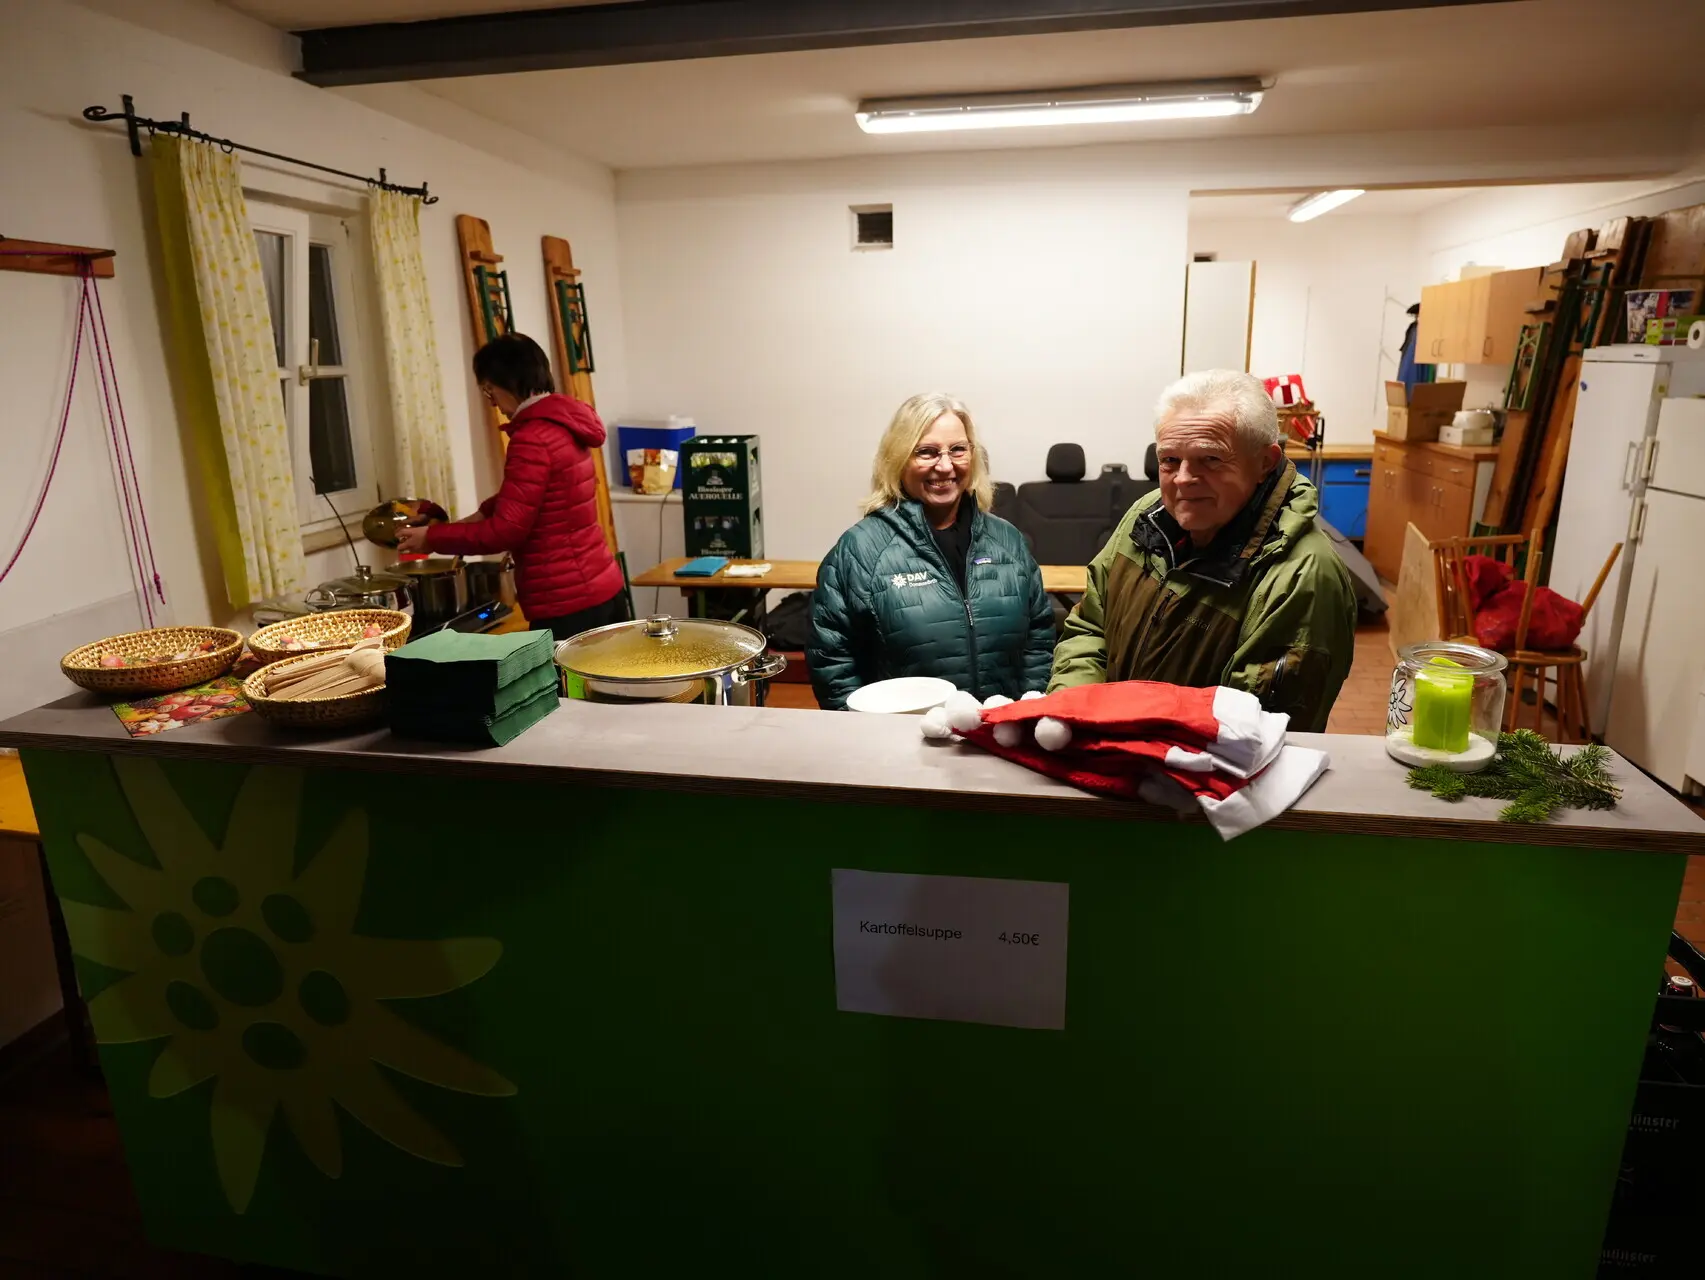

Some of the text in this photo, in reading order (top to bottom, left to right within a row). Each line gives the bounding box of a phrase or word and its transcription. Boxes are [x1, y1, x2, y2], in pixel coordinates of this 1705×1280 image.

[907, 571, 927, 582] DAV
[859, 920, 1040, 946] Kartoffelsuppe 4,50€
